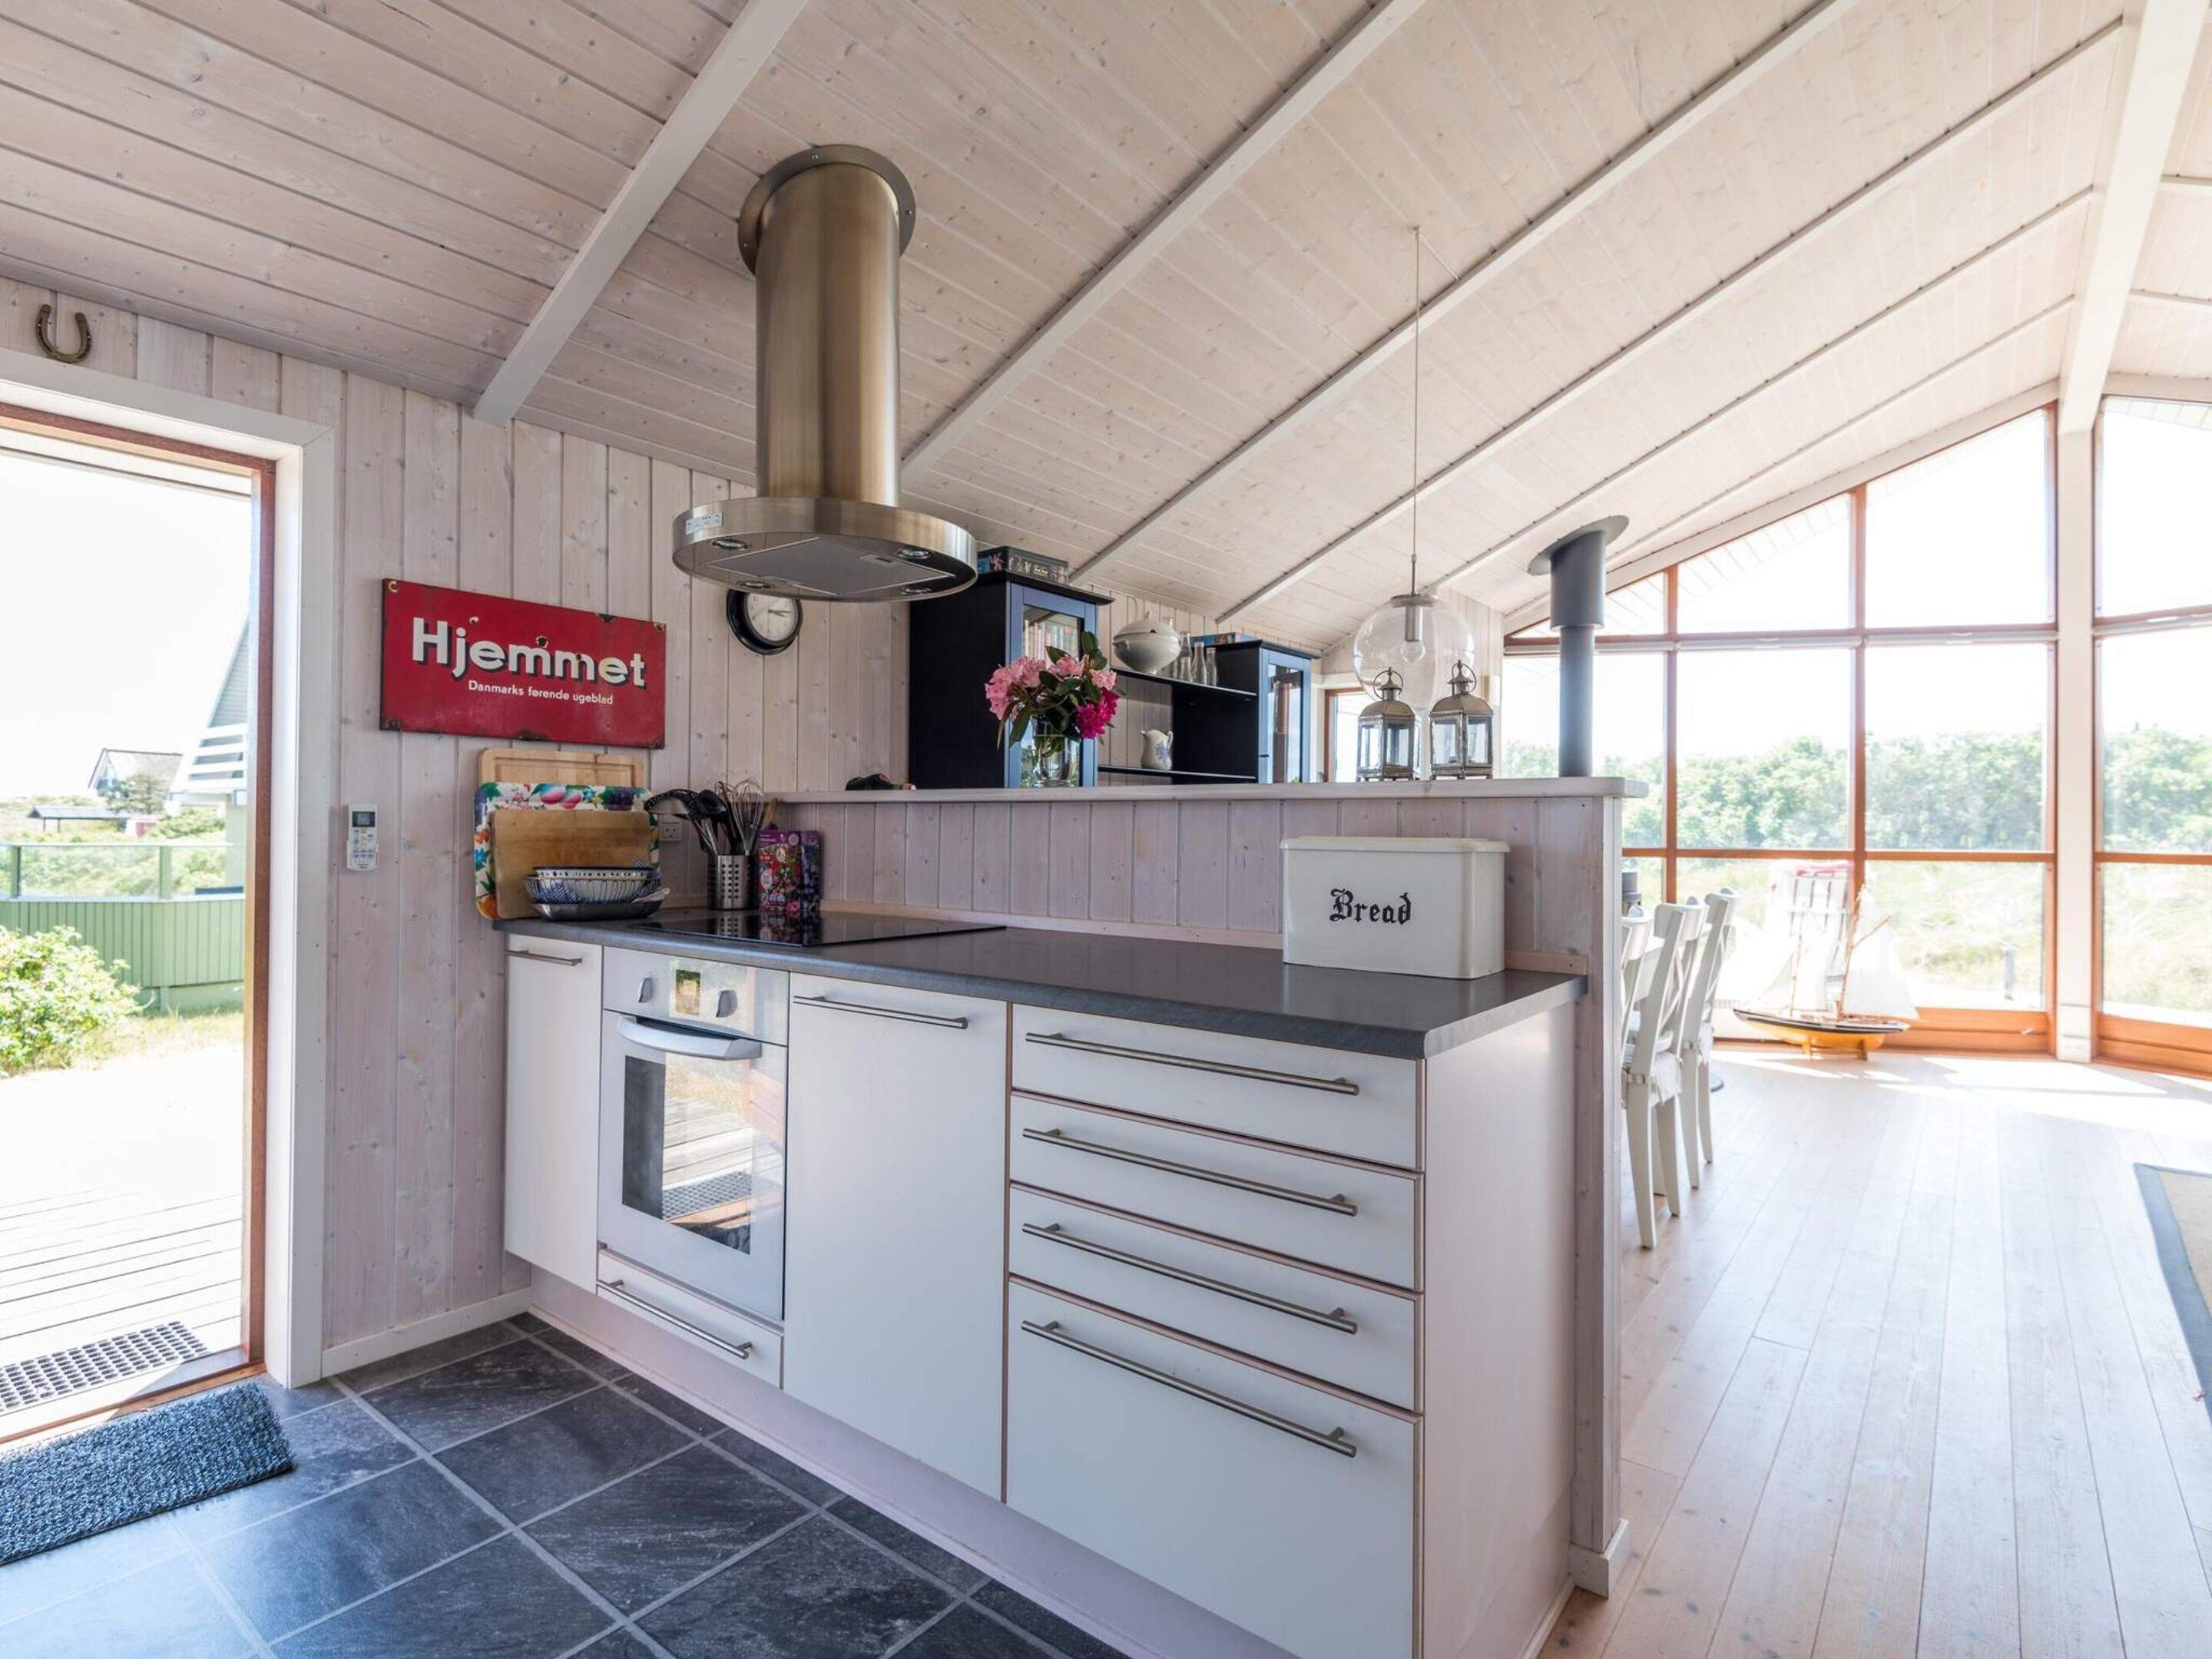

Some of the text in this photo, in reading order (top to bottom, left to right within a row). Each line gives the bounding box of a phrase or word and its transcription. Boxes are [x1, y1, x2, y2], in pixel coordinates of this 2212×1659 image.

[412, 617, 646, 686] Hjemmet
[468, 679, 614, 705] Danmarks førende ugeblad
[1329, 887, 1412, 926] Bread
